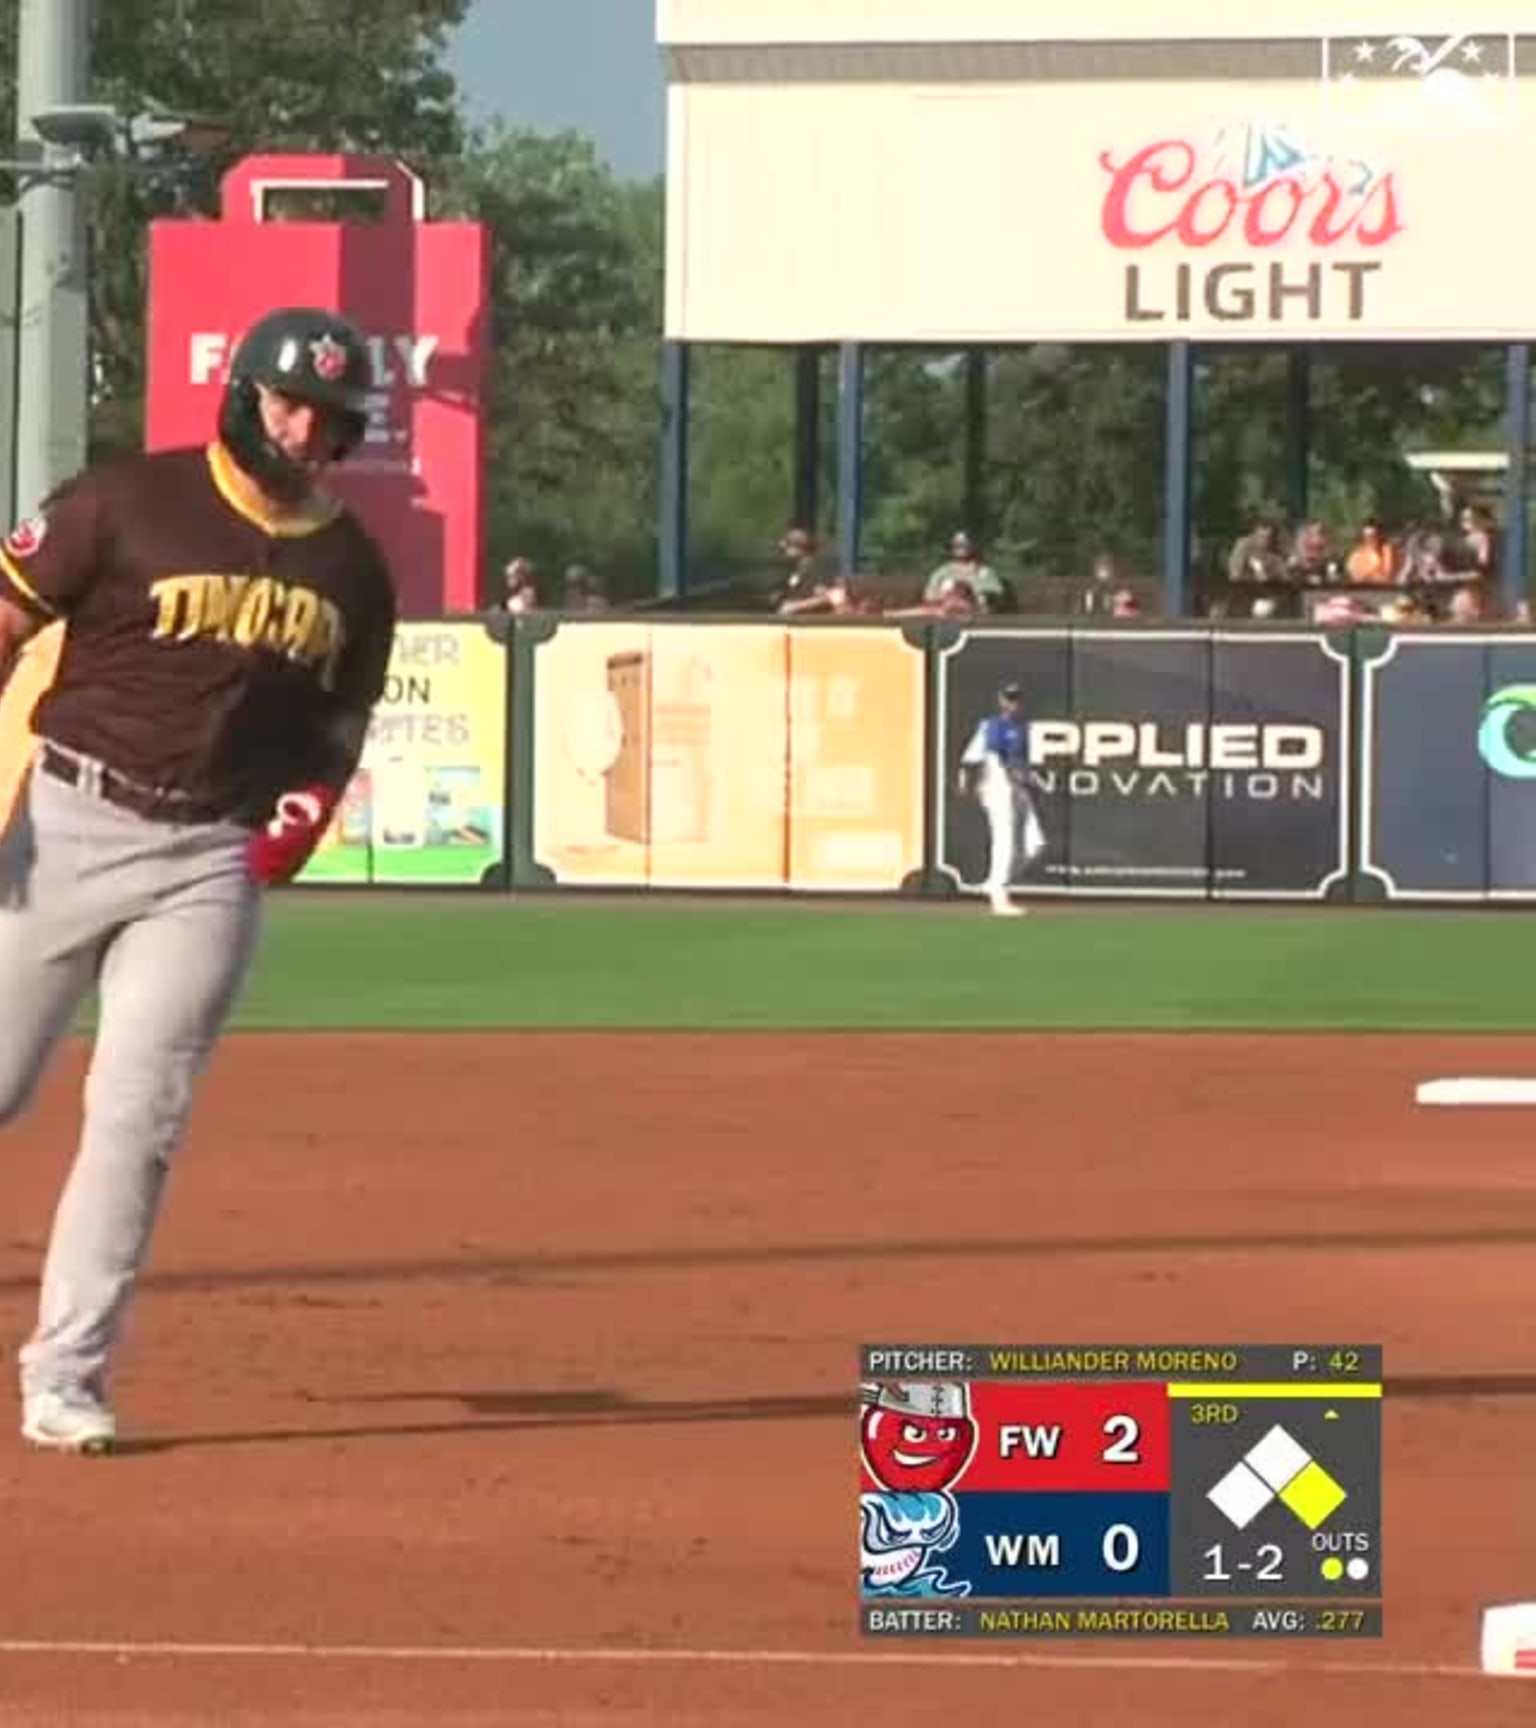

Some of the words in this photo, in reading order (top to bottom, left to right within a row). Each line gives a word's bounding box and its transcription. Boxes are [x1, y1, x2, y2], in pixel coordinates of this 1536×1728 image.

[1099, 140, 1404, 249] Coors
[1125, 261, 1382, 321] LIGHT
[1028, 721, 1323, 769] PPLIED
